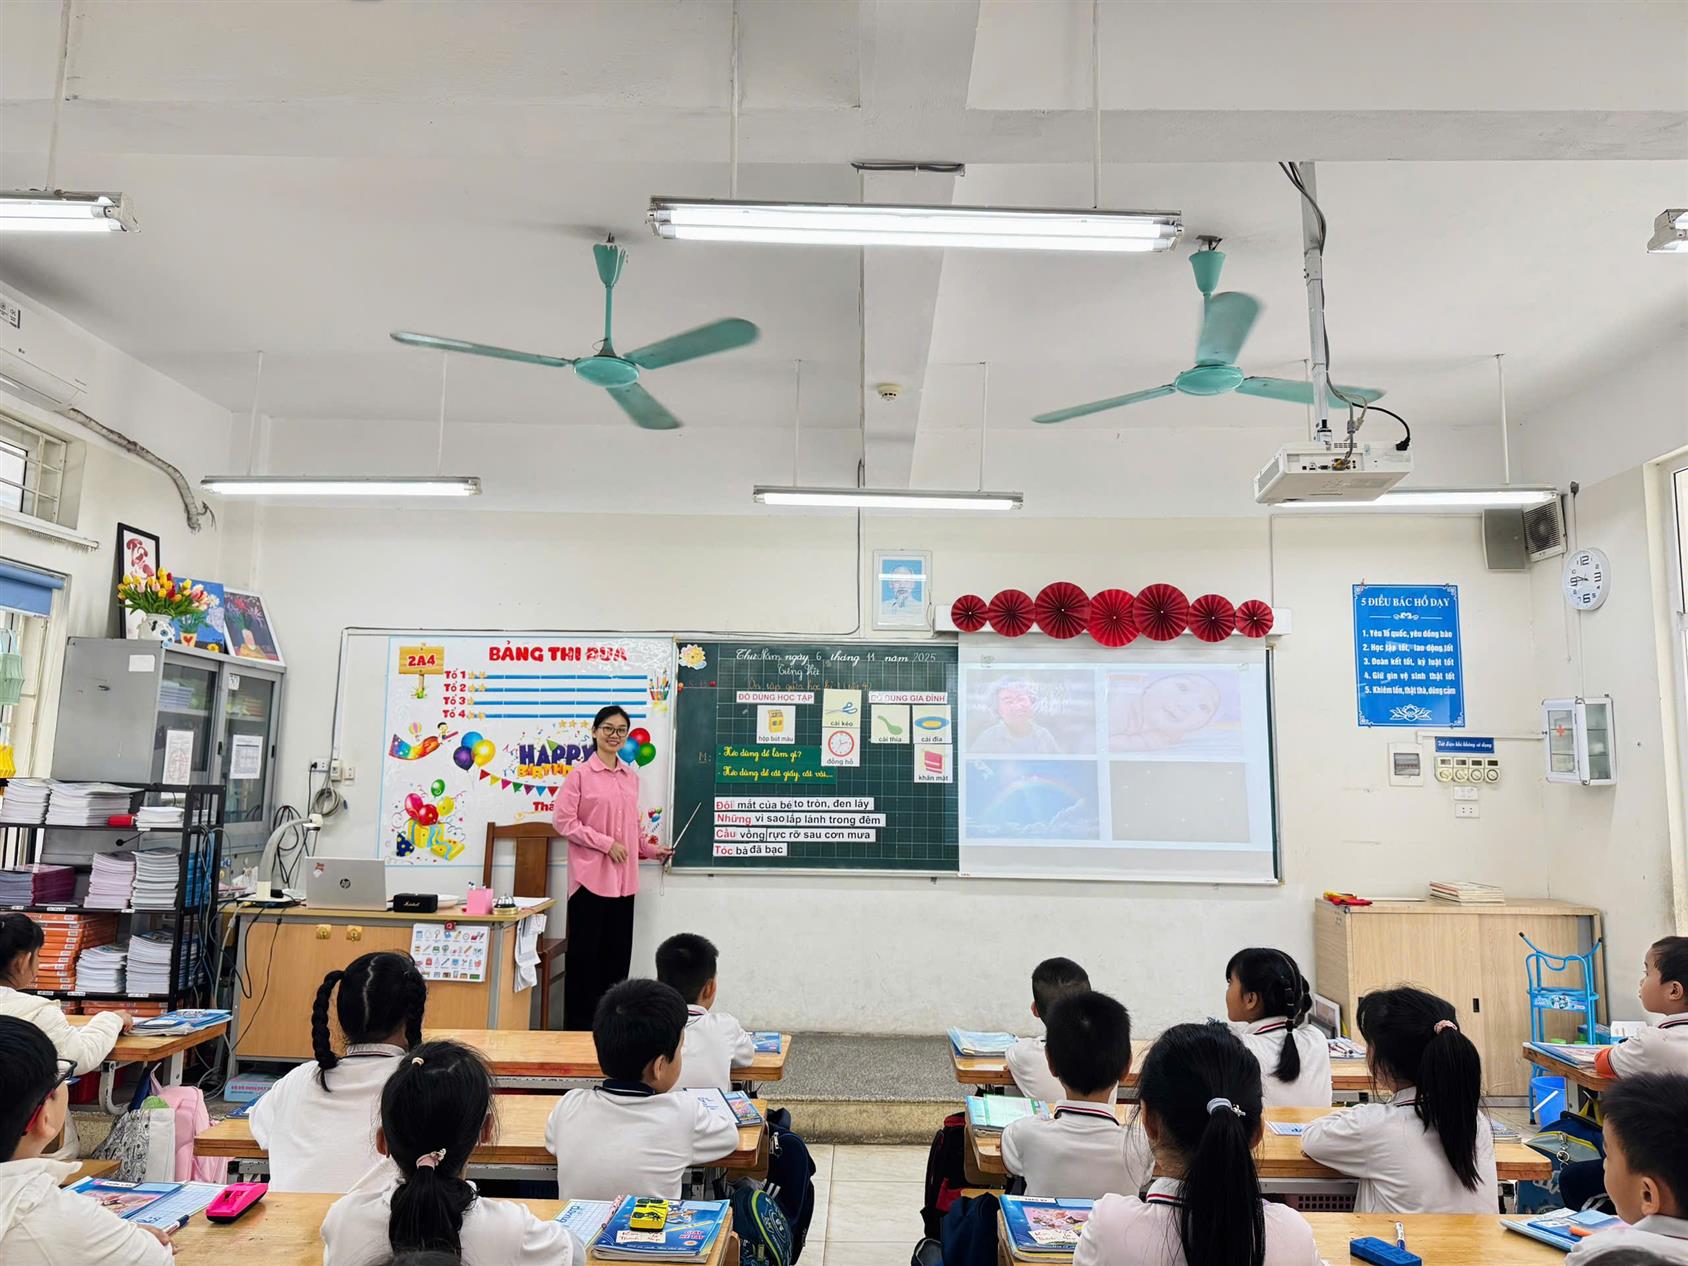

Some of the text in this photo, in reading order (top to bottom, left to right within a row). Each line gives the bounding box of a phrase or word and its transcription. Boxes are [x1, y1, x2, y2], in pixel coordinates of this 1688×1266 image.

[1580, 555, 1589, 566] 12
[1594, 572, 1601, 582] 3
[1361, 594, 1450, 608] 5 ĐIỀU BÁC HỒ DẠY
[1583, 594, 1590, 603] 6
[488, 640, 628, 662] BẢNG THI ĐUA
[1371, 644, 1384, 652] Học
[408, 655, 436, 666] 2A4
[784, 653, 809, 665] ngày
[816, 652, 821, 660] 6
[830, 650, 860, 666] tháng
[867, 652, 876, 661] 11
[913, 652, 936, 662] 2025
[444, 668, 466, 679] Tổ 1
[1411, 672, 1426, 680] sinh
[444, 681, 466, 692] Tổ 2
[1365, 686, 1371, 694] 5.
[443, 694, 466, 705] Tổ 3
[738, 692, 813, 702] ĐỒ DÙNG HỌC TẬP
[926, 694, 945, 702] ĐÌNH
[442, 707, 466, 718] Tổ 4
[519, 744, 596, 766] HAPPY
[533, 800, 554, 812] Thá
[716, 798, 869, 810] Đôi mắt của bé to tròn, đen láy
[717, 814, 752, 826] Những
[786, 813, 802, 826] lấp
[804, 814, 826, 825] lánh
[829, 816, 856, 827] trong
[859, 815, 880, 824] đêm
[716, 828, 736, 838] Cầu
[769, 832, 786, 840] rực
[789, 830, 801, 838] rỡ
[715, 845, 783, 856] Tóc bà đã bạc
